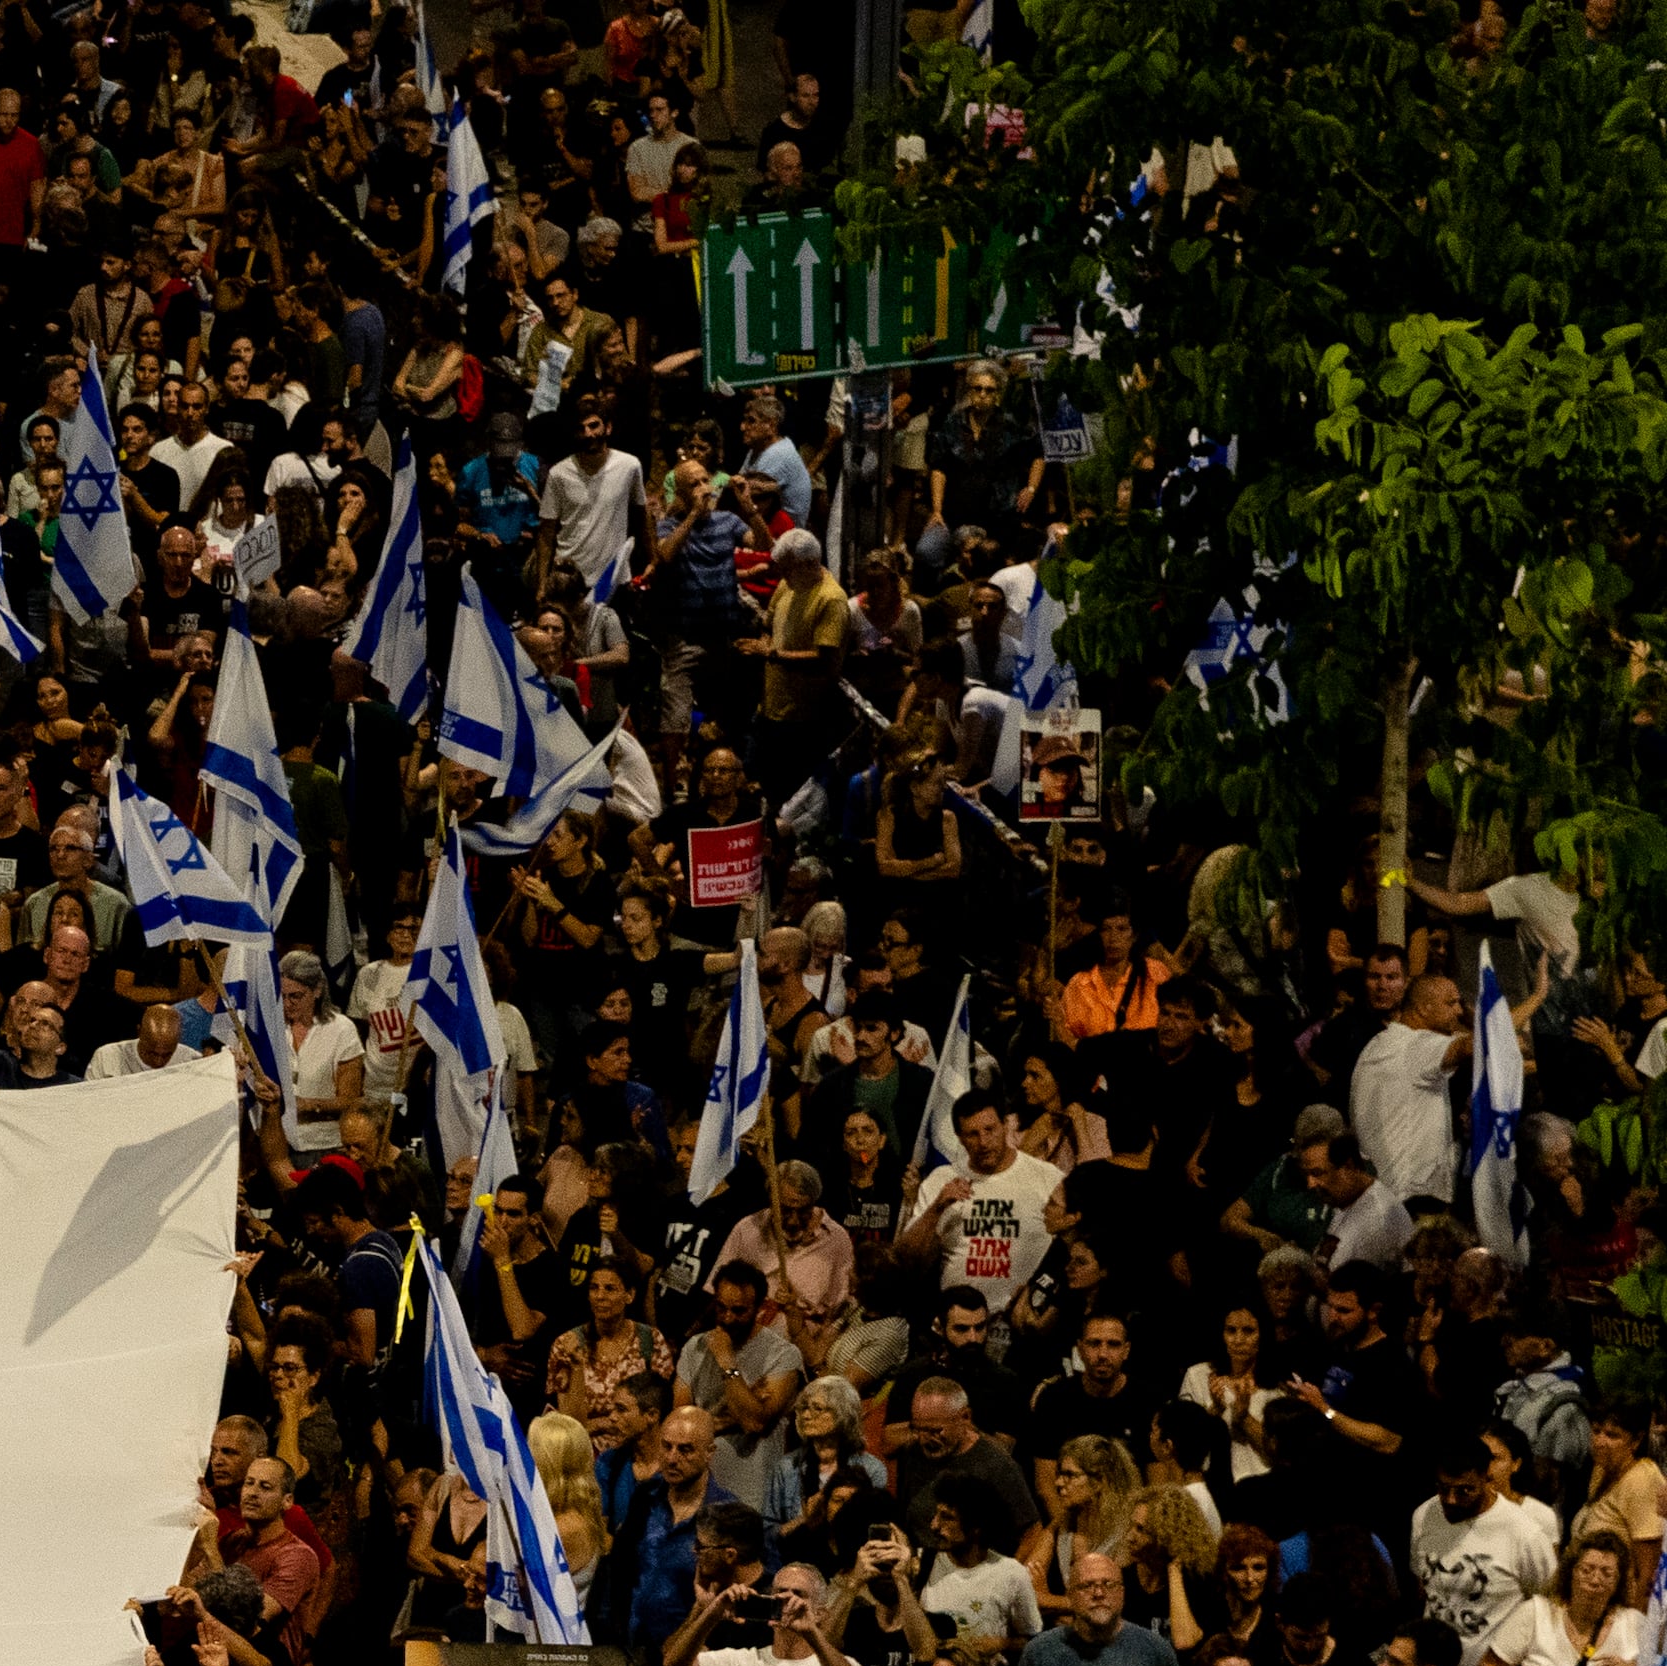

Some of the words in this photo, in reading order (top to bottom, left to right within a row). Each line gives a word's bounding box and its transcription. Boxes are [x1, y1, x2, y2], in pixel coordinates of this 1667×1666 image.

[970, 1199, 1014, 1218] אתה
[963, 1219, 1020, 1239] הראש
[968, 1239, 1011, 1258] אתה
[965, 1258, 1011, 1280] אשם
